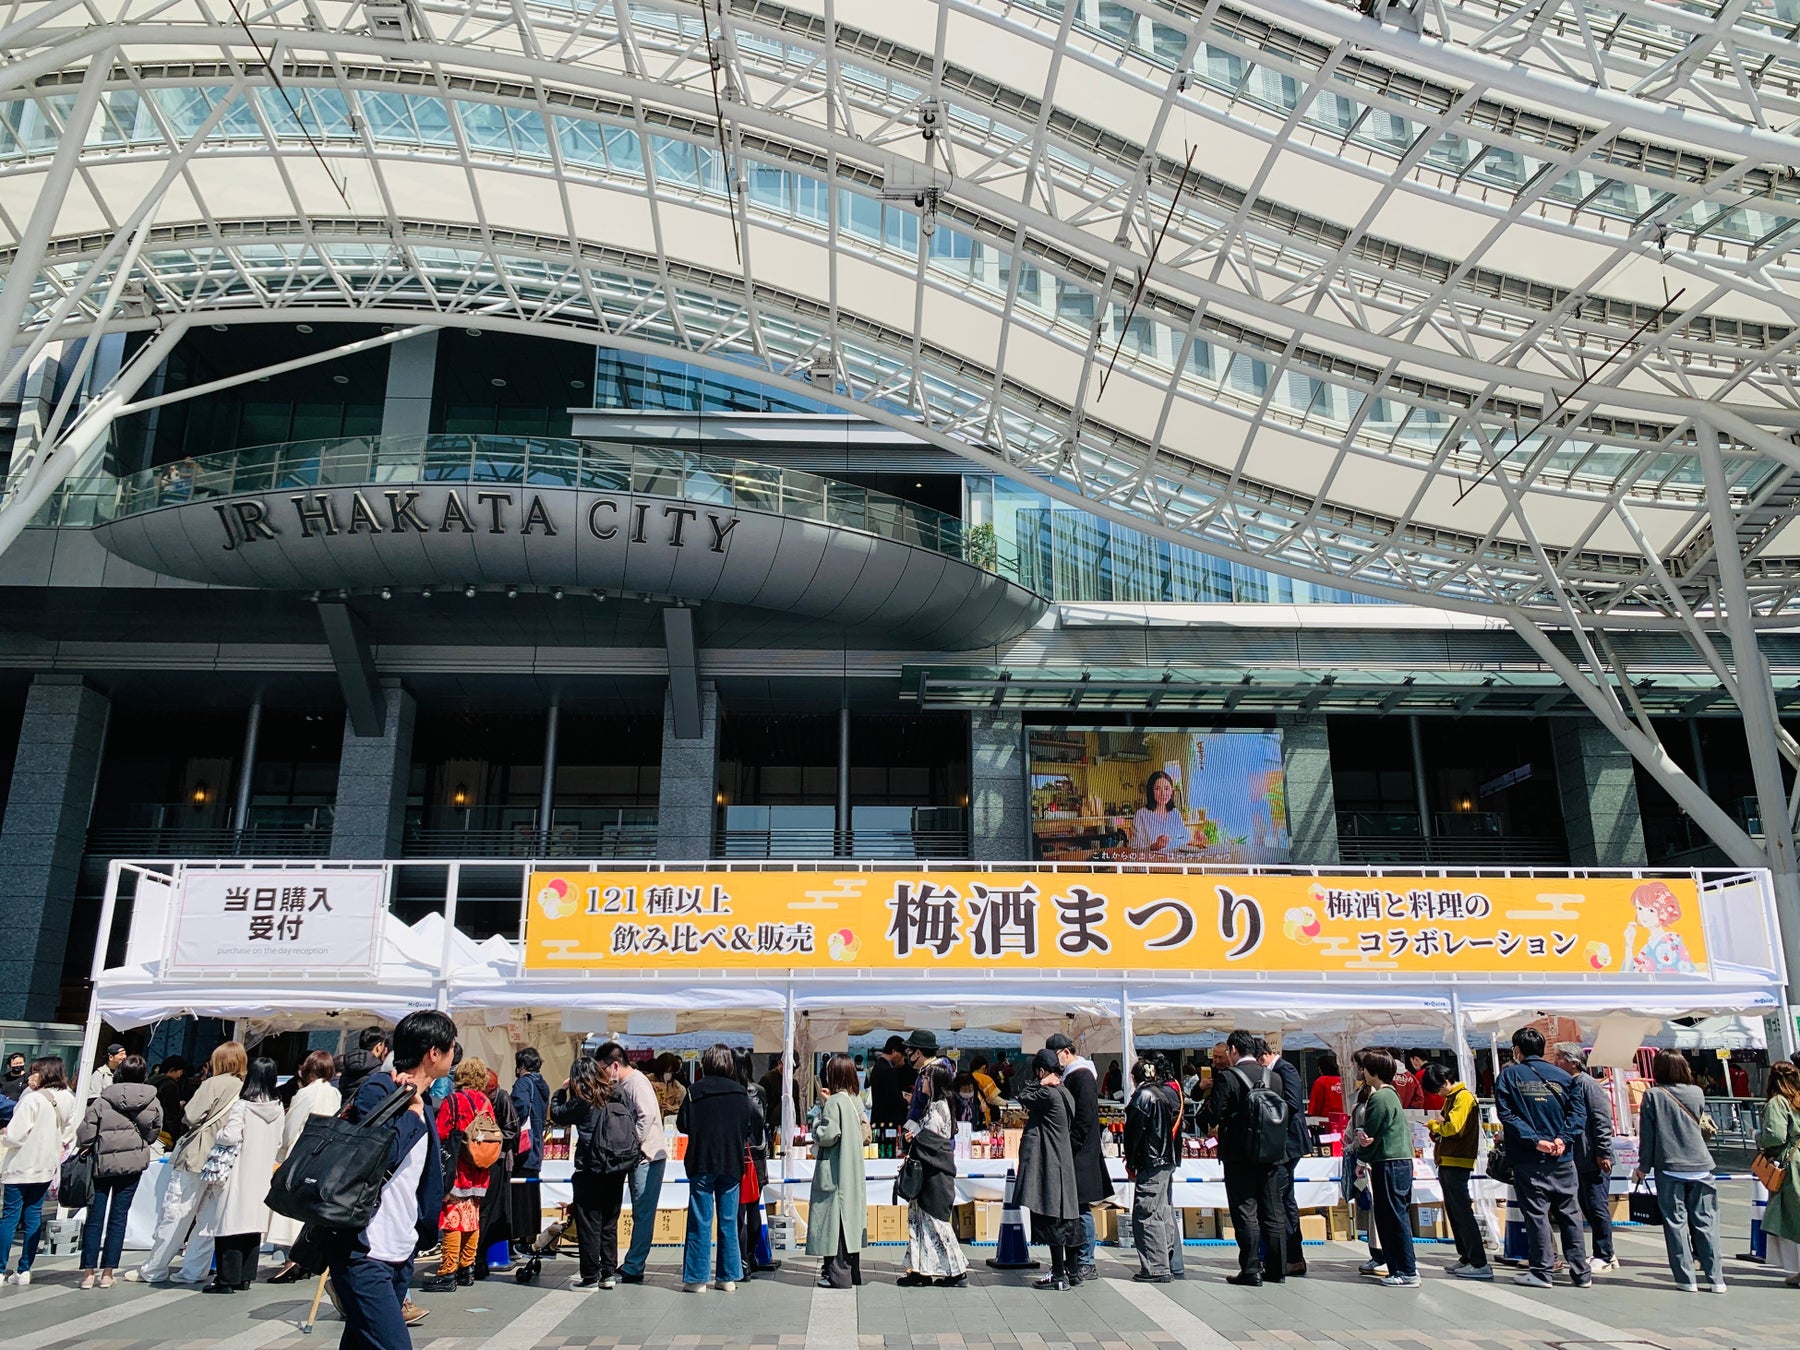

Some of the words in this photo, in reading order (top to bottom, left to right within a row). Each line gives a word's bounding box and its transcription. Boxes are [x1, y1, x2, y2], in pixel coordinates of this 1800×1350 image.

[212, 500, 280, 552] JR
[290, 489, 559, 538] HAKATA
[587, 500, 741, 554] CITY
[223, 887, 333, 913] 当日購入
[586, 886, 638, 914] 121
[646, 886, 732, 914] 種以上
[1325, 890, 1491, 919] 梅酒と料理の
[248, 915, 304, 941] 受付
[888, 884, 1262, 957] 梅酒まつり
[217, 947, 251, 955] purchase
[277, 947, 291, 956] day
[292, 947, 328, 955] reception
[612, 924, 815, 953] 飲み比べ&販売
[1359, 930, 1578, 956] コラボレーション
